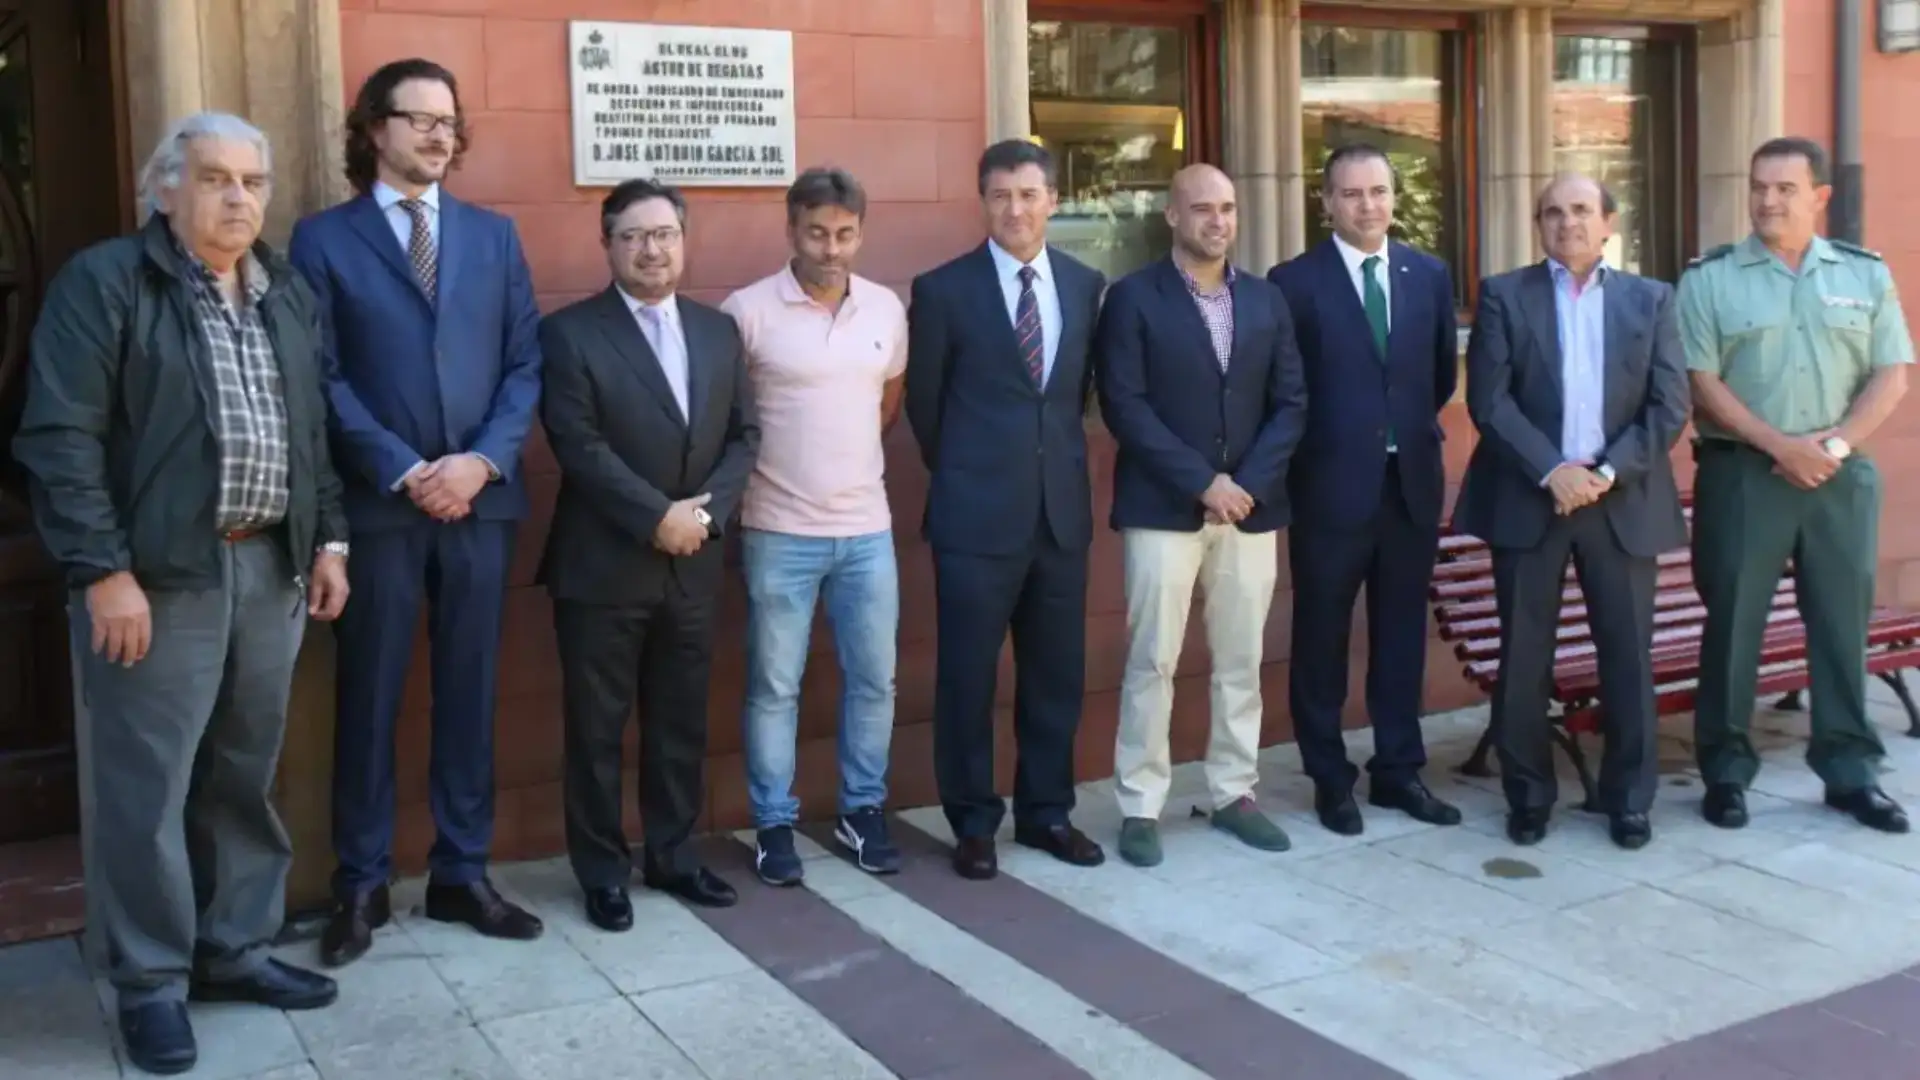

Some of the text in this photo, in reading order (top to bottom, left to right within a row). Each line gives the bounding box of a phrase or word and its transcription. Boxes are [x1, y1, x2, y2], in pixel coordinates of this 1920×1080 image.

[643, 61, 764, 79] ASTUR DE REGATAS
[645, 144, 703, 162] ANTONIO
[707, 145, 755, 162] GARCIA
[761, 145, 784, 163] SOL
